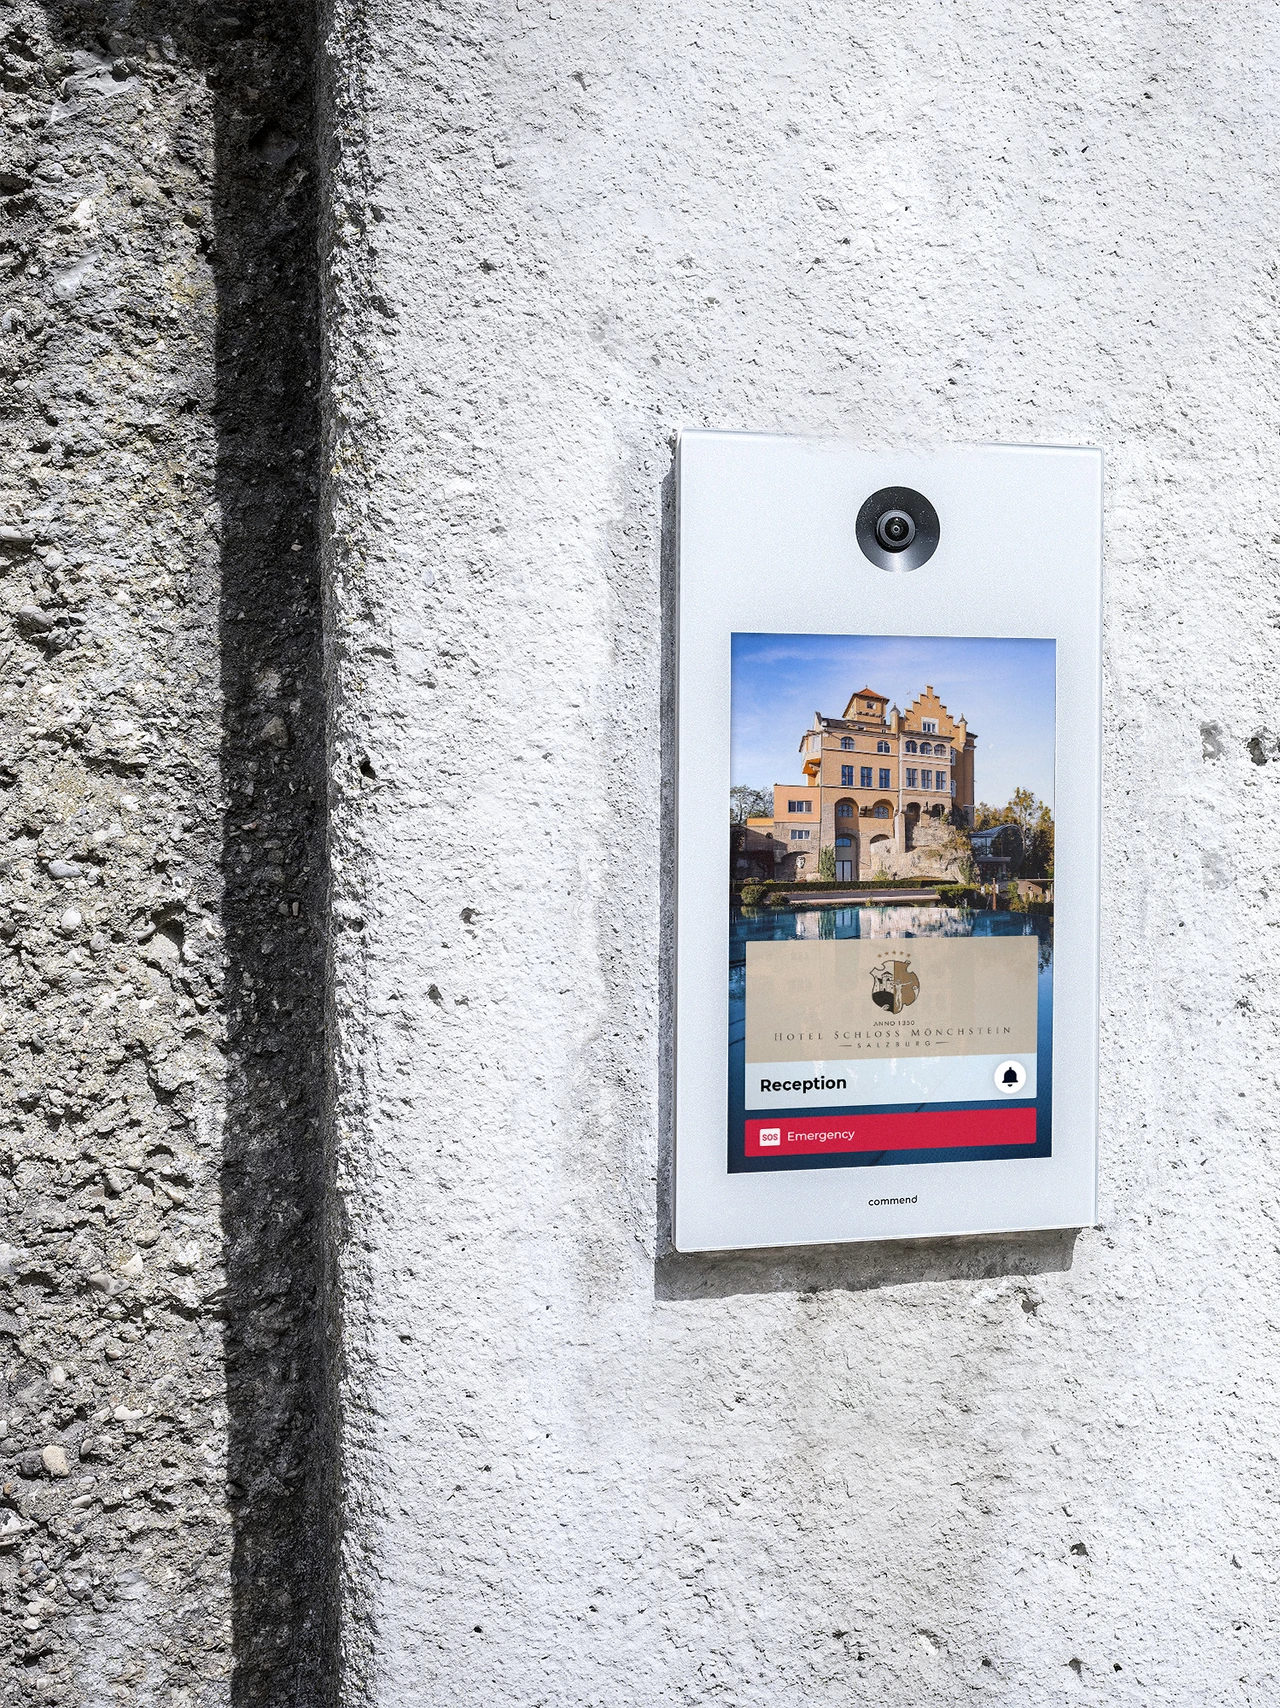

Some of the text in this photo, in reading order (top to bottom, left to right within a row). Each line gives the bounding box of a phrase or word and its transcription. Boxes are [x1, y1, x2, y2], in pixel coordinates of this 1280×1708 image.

[774, 1033, 823, 1041] HOTEL
[834, 1030, 900, 1040] SCHLOSS
[857, 1040, 931, 1049] SALZBURG
[760, 1075, 846, 1093] Reception
[762, 1131, 855, 1142] SOS Emergency
[868, 1194, 918, 1206] commend
